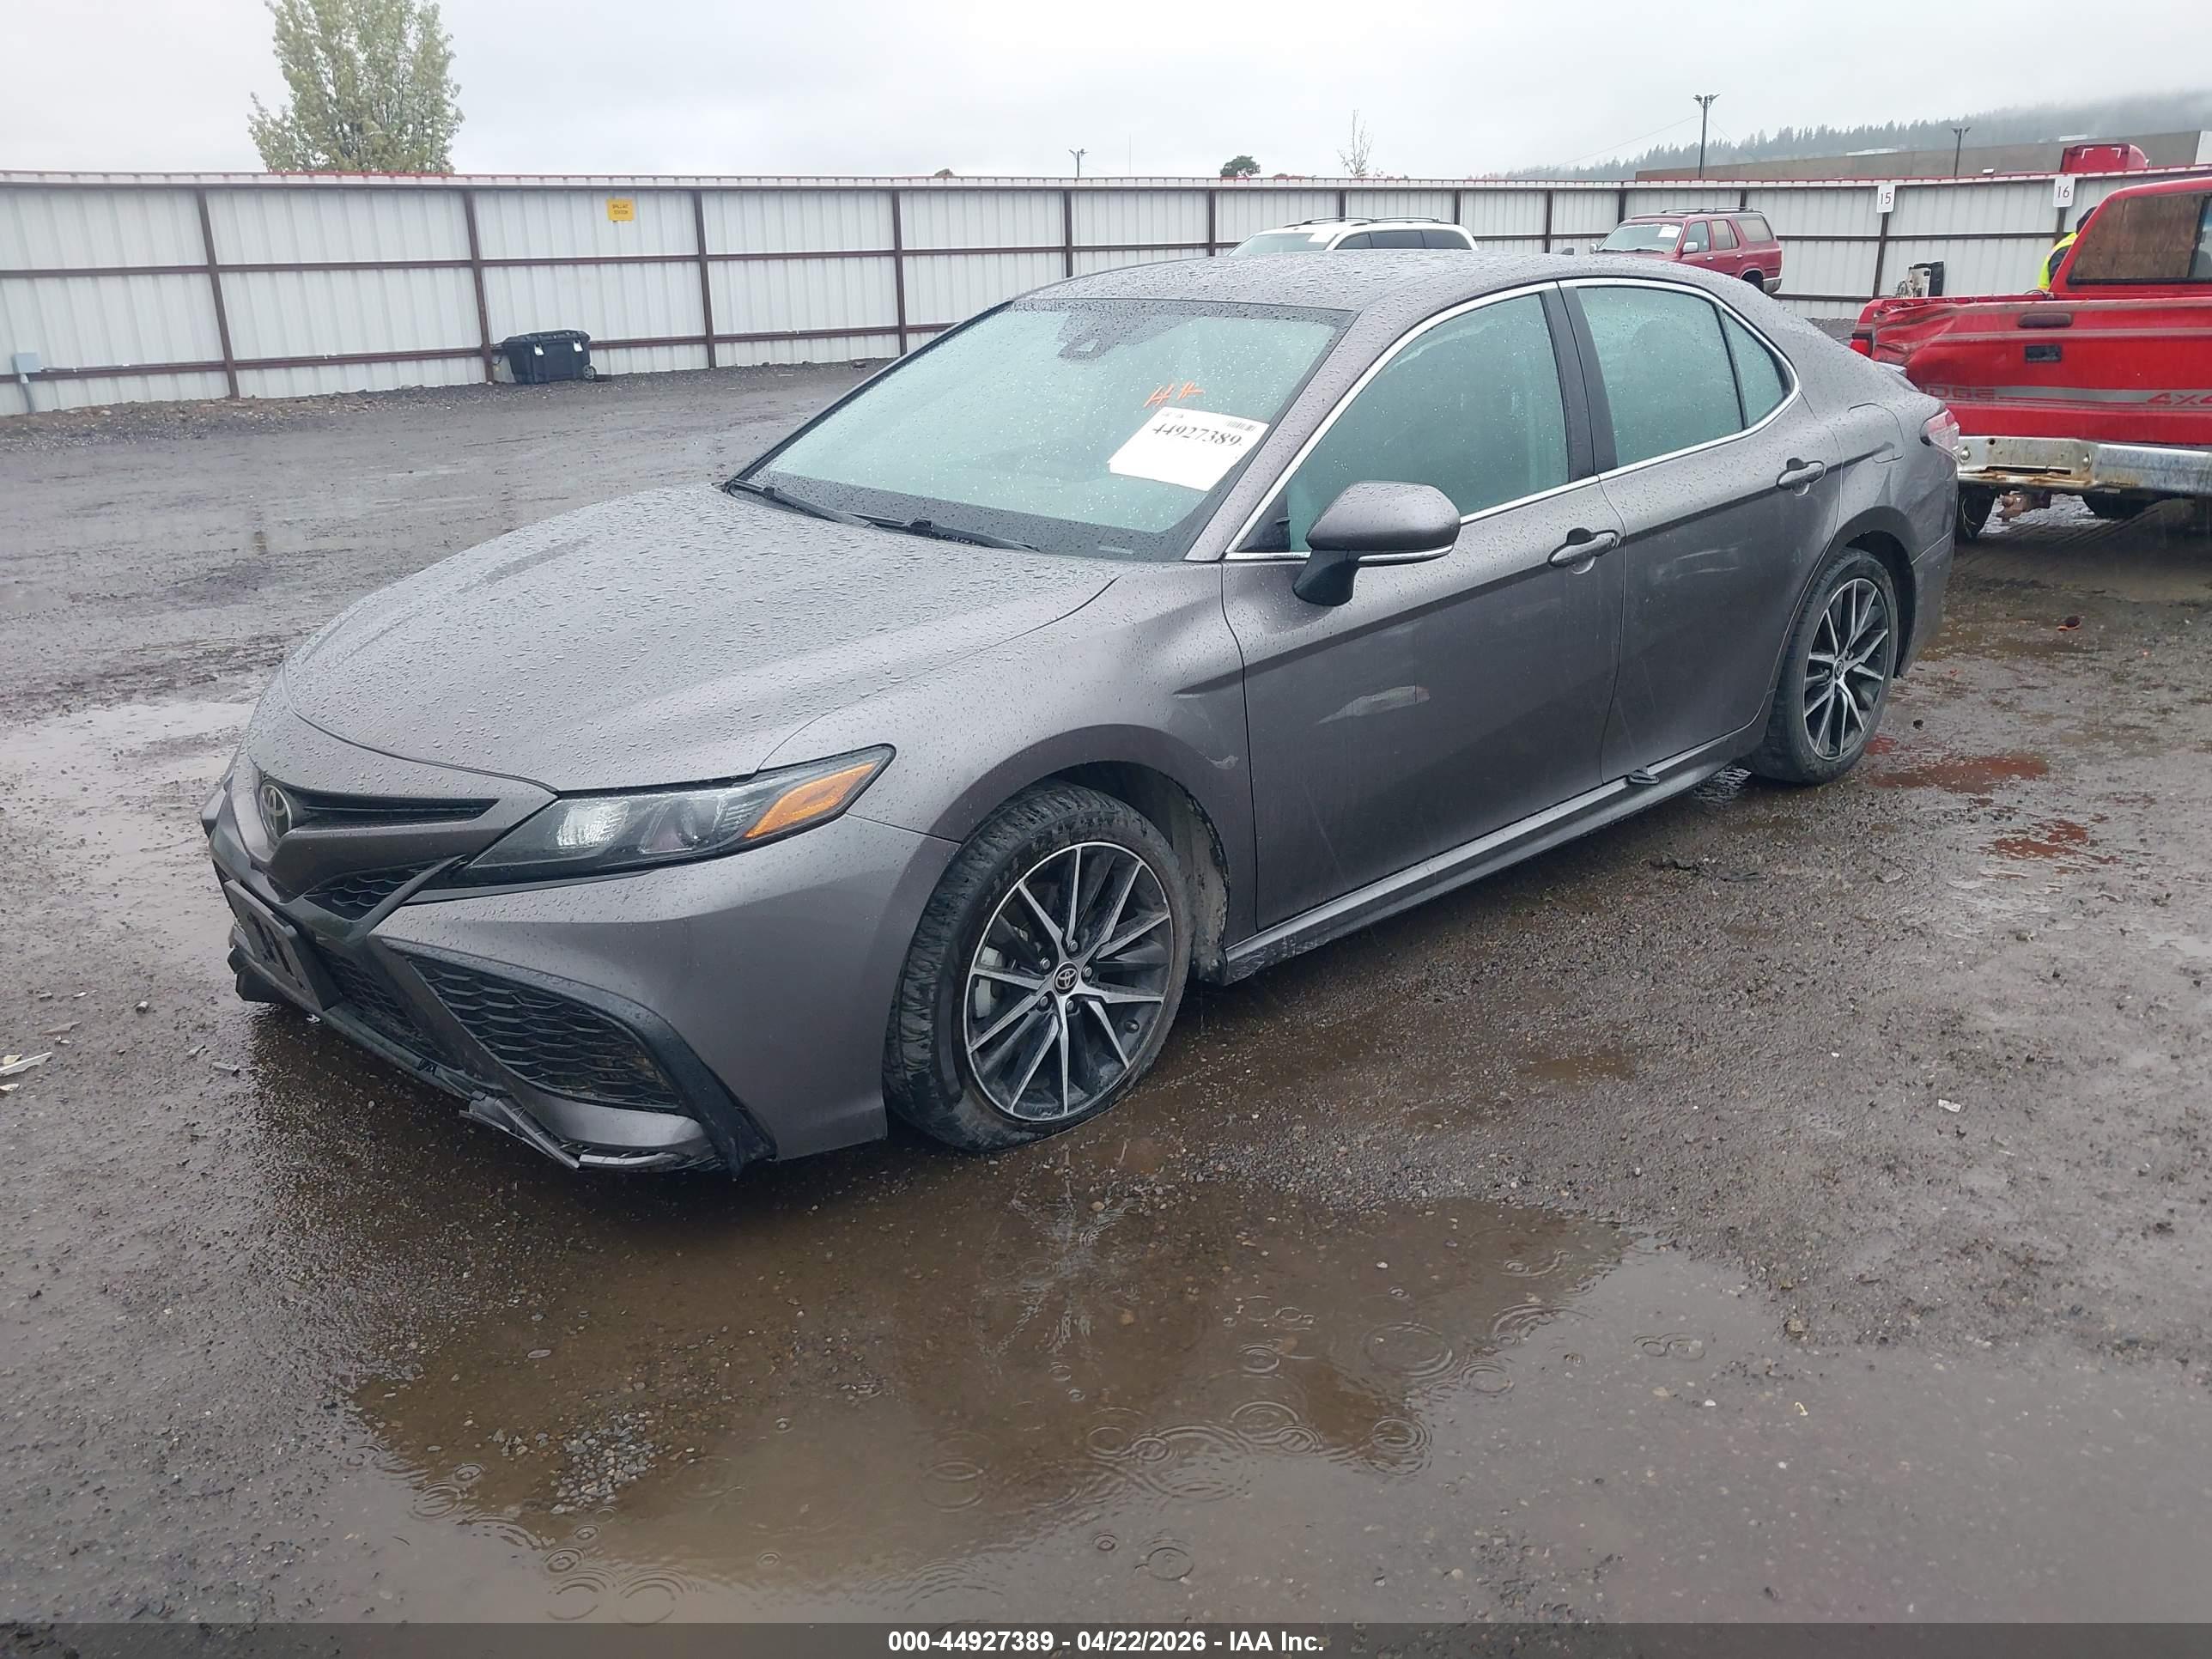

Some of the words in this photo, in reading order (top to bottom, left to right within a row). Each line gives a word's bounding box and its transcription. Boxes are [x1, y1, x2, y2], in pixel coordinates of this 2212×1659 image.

[1881, 191, 1892, 205] 15
[2057, 185, 2069, 198] 16
[1920, 385, 1995, 400] DGE
[1152, 422, 1243, 447] 44927389
